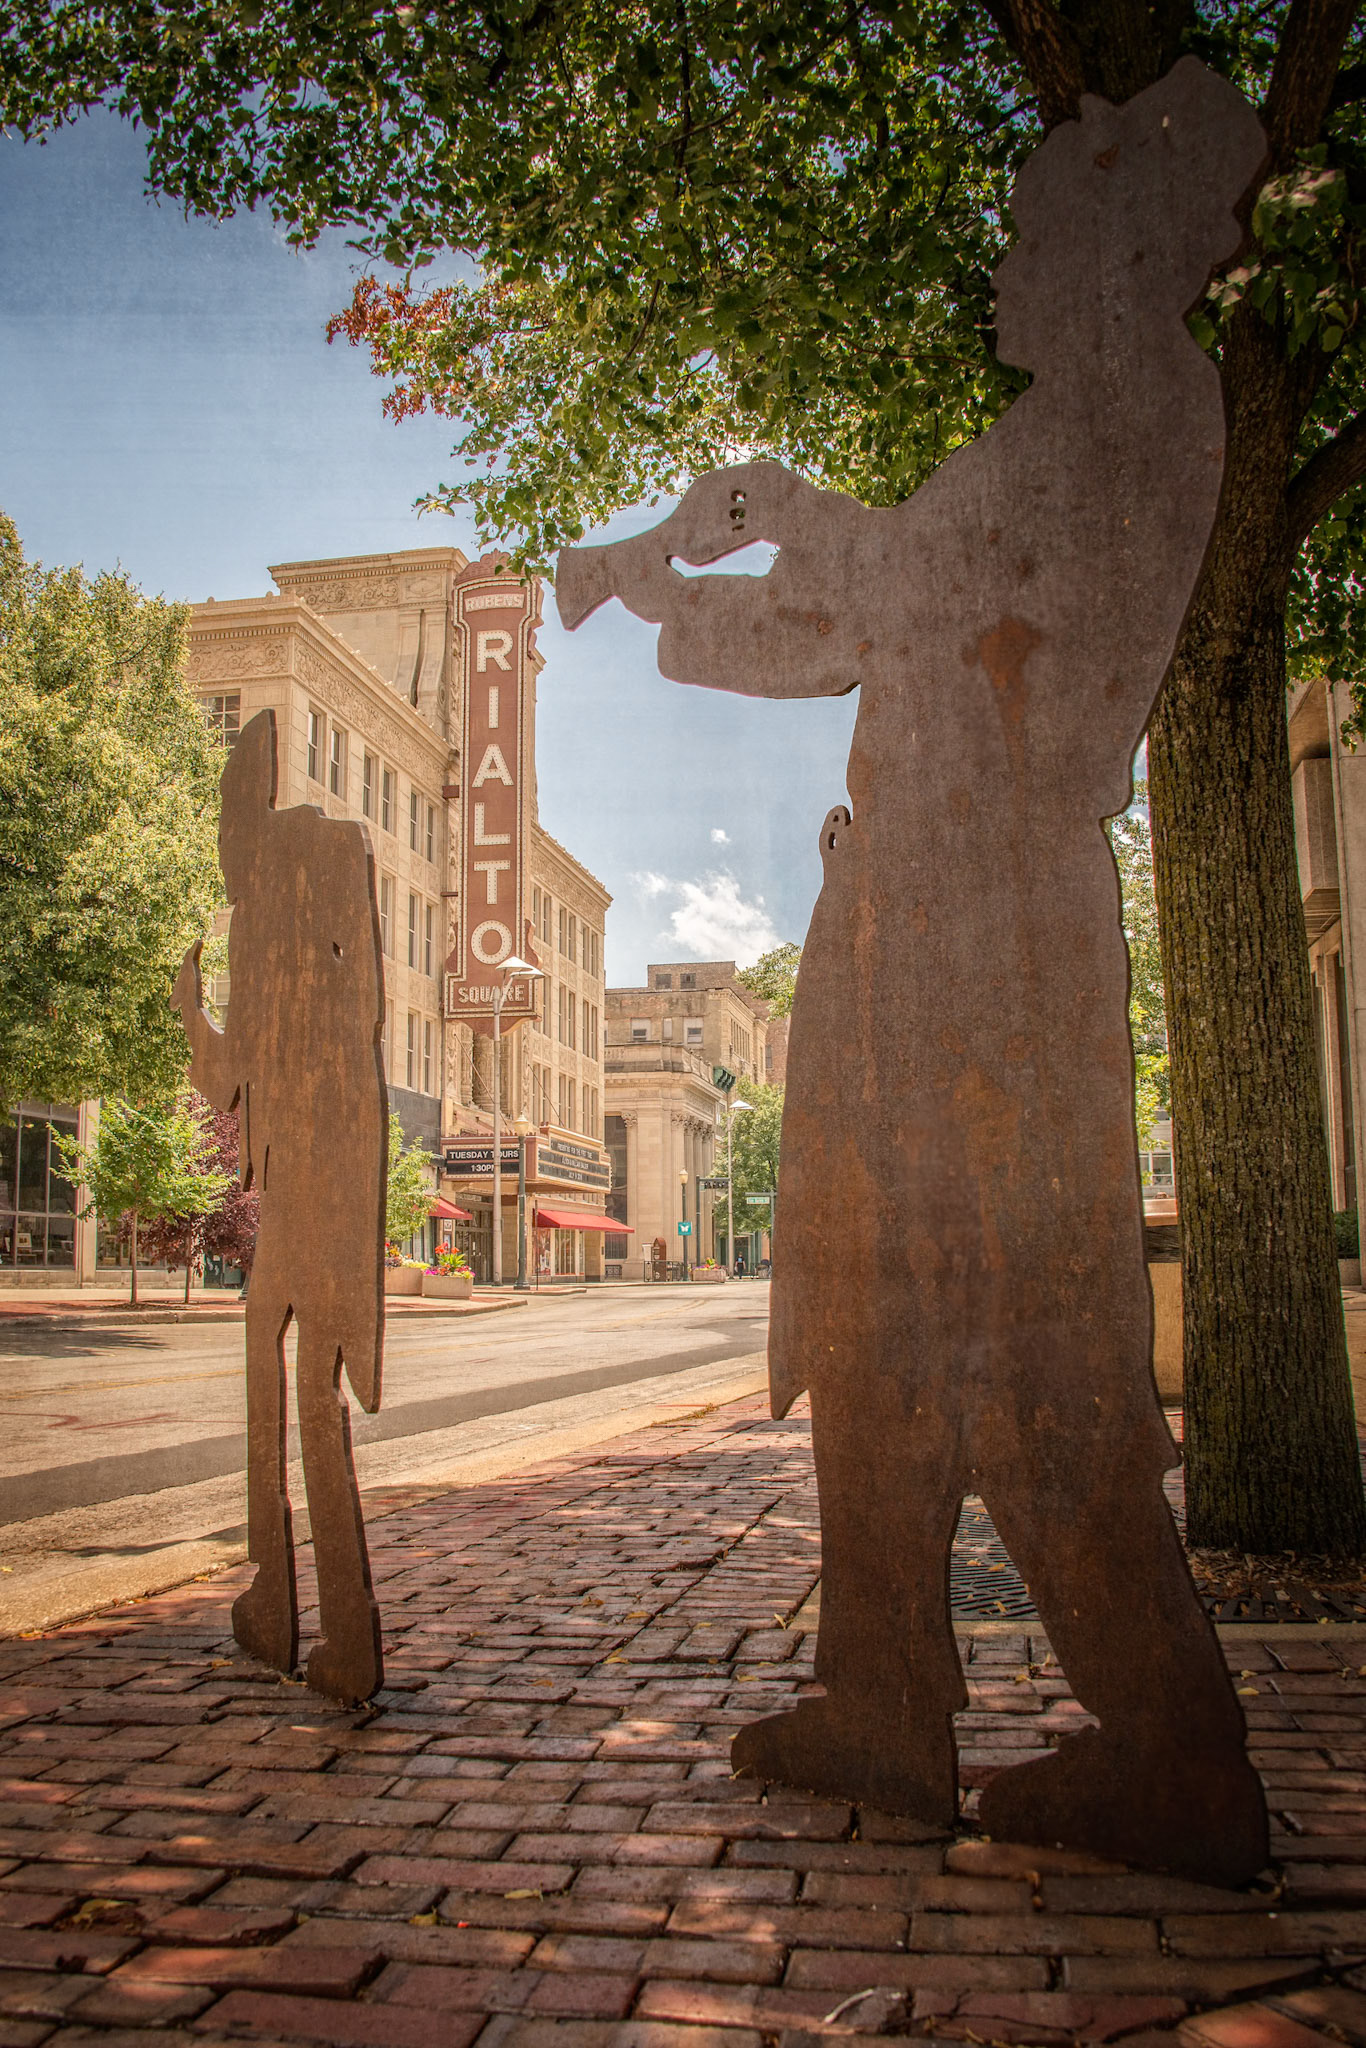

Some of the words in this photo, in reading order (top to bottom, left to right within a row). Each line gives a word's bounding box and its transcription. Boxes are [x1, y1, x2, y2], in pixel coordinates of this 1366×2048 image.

[465, 594, 524, 612] RUBENS
[471, 630, 513, 965] RIALTO
[450, 1151, 489, 1159] TUESDAY
